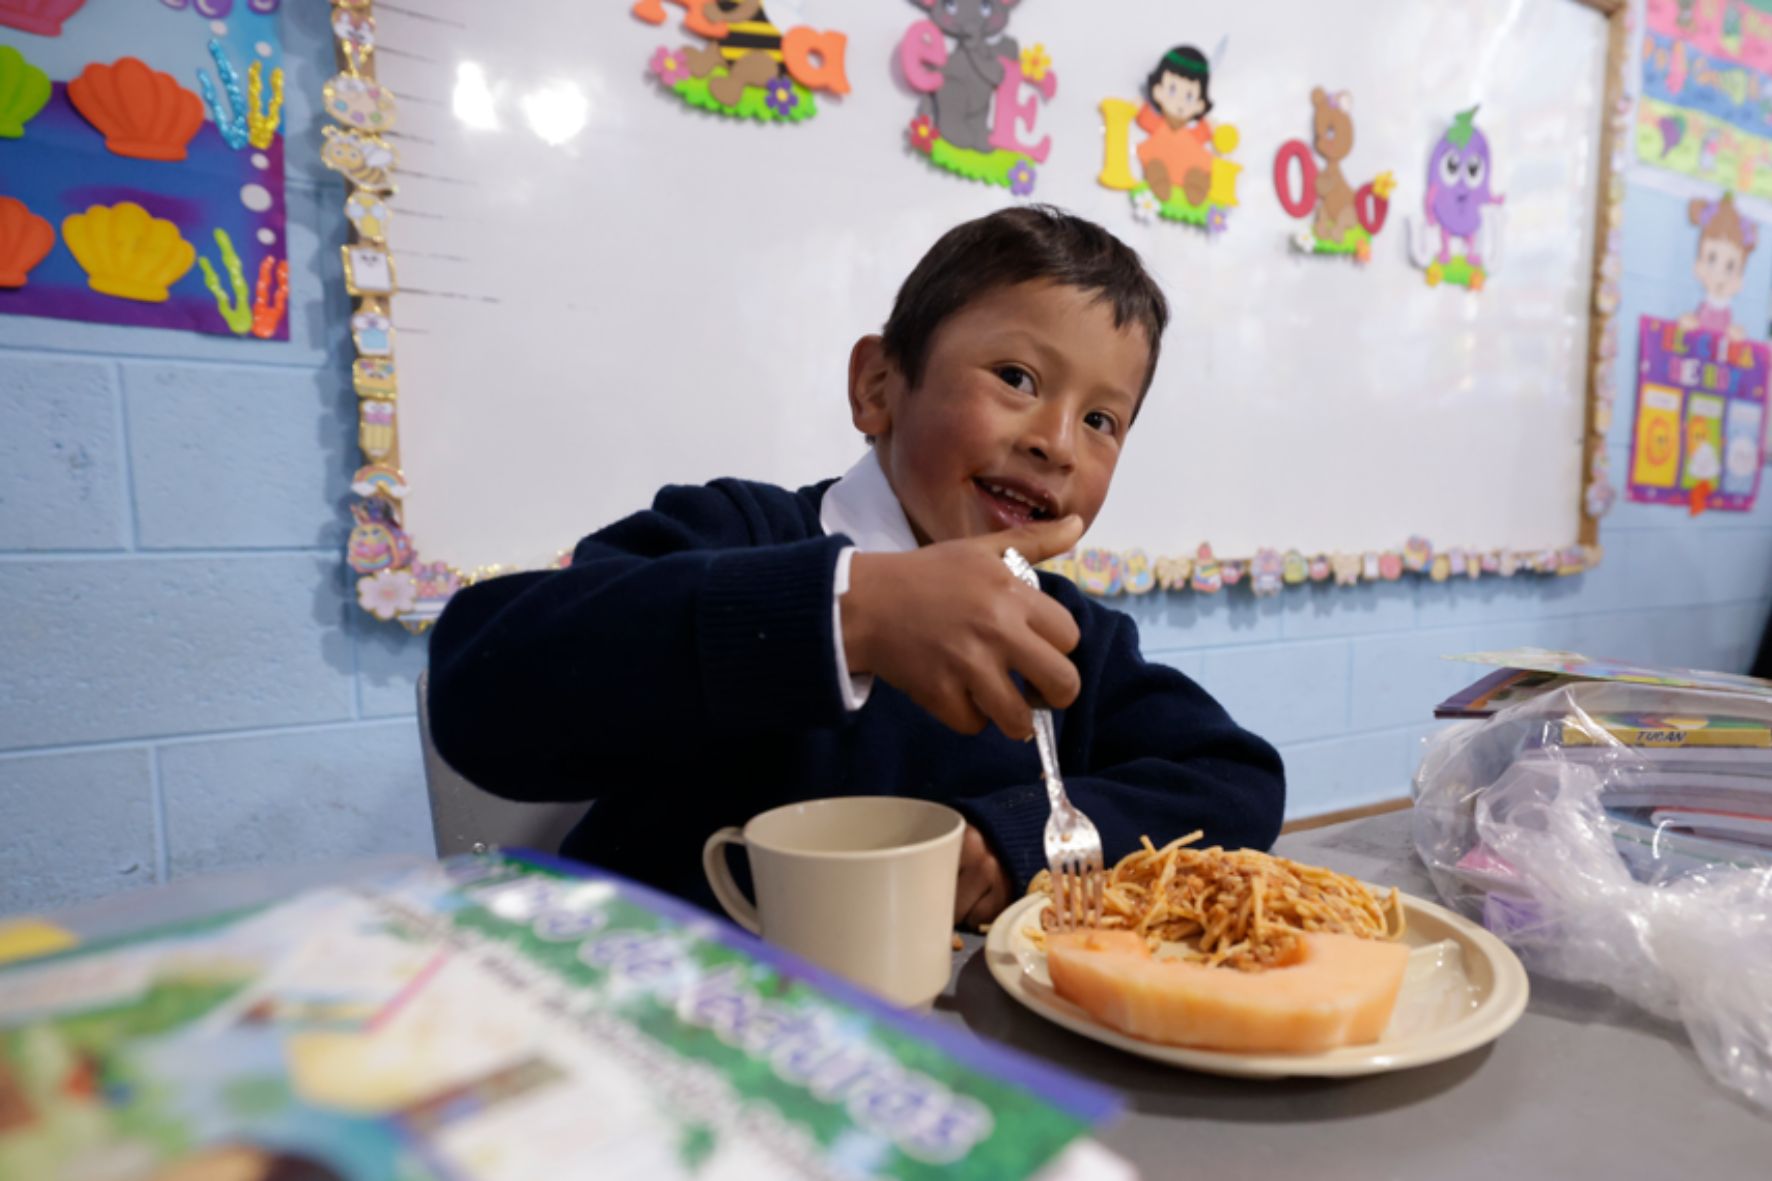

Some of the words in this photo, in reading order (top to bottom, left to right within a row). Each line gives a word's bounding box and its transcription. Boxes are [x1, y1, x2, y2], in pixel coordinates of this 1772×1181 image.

[780, 26, 851, 94] a
[901, 19, 947, 92] e
[990, 56, 1057, 163] E
[1098, 98, 1138, 190] I
